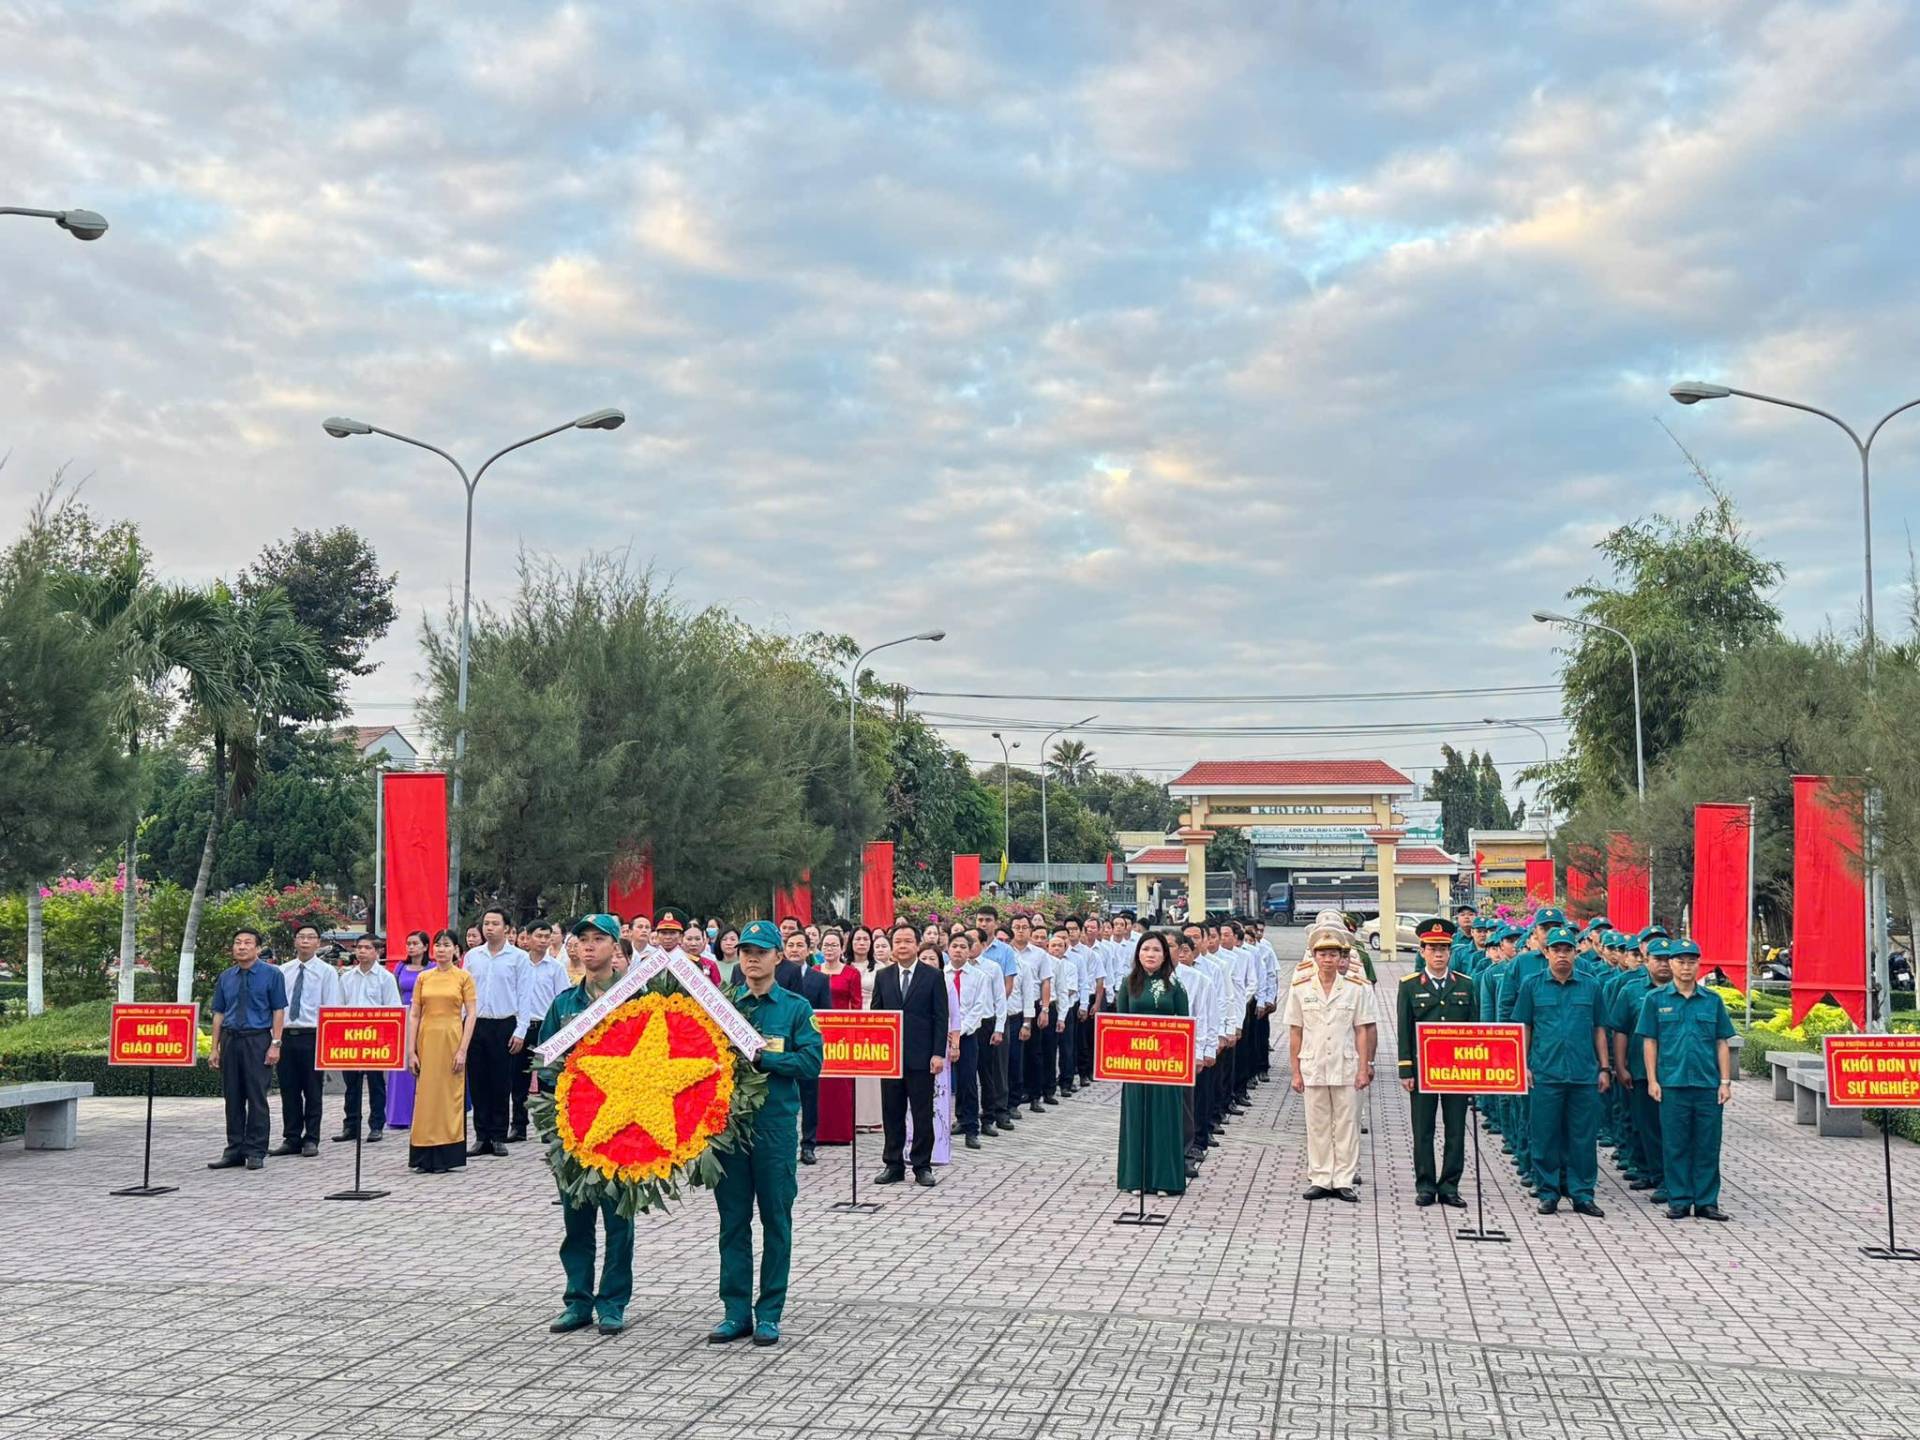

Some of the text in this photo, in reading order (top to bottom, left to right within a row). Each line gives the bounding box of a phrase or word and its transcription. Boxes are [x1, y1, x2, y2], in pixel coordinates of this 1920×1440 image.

[137, 1020, 168, 1036] KHỐI
[344, 1025, 377, 1041] KHỐI
[121, 1040, 183, 1056] GIÁO DỤC
[329, 1043, 391, 1059] KHU PHỐ
[853, 1038, 890, 1061] ĐẢNG
[1130, 1034, 1159, 1051] KHỐI
[1454, 1042, 1489, 1060] KHỐI
[1105, 1054, 1142, 1070] CHÍNH
[1841, 1054, 1874, 1073] KHỐI
[1876, 1058, 1906, 1073] ĐƠN
[1429, 1065, 1516, 1084] NGÀNH DỌC
[1847, 1078, 1919, 1098] SỰ NGHIỆP
